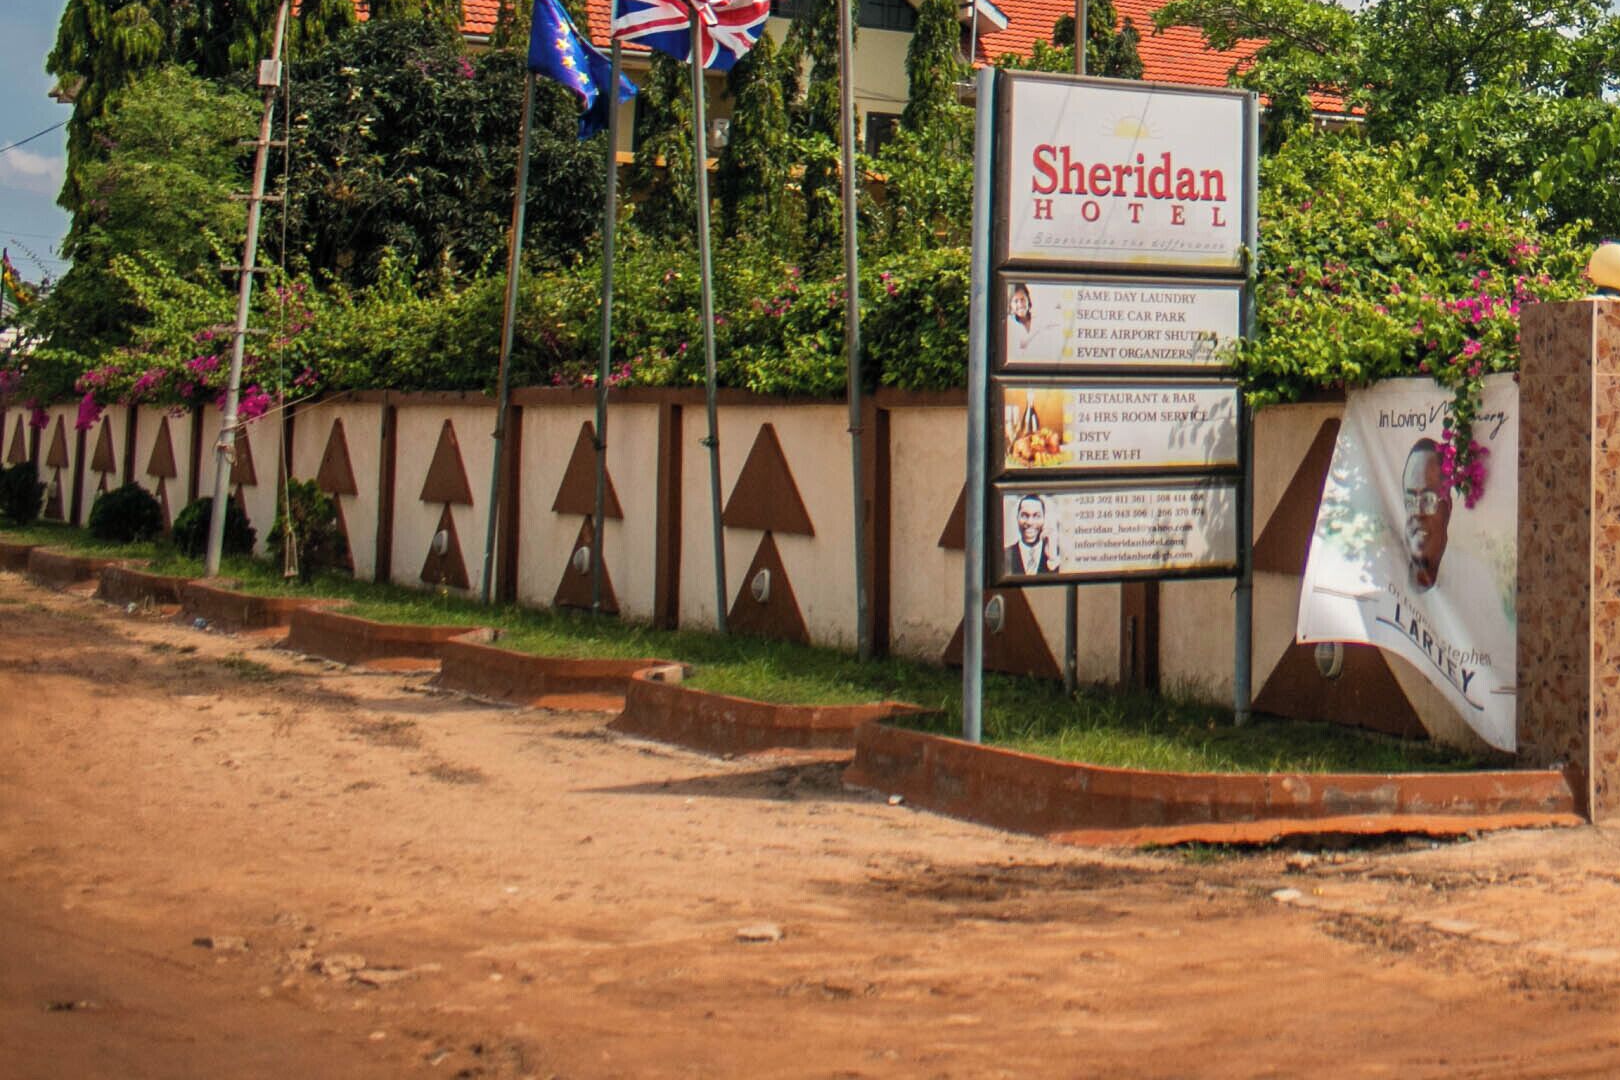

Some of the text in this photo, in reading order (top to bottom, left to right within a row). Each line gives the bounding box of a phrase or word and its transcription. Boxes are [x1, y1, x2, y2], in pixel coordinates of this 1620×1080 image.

[1031, 144, 1227, 201] Sheridan
[1033, 198, 1226, 227] HOTEL
[1078, 289, 1197, 304] SAME DAY LAUNDRY
[1077, 309, 1186, 322] SECURE CAR PARK
[1077, 328, 1108, 339] FREE
[1110, 329, 1161, 340] AIRPORT
[1077, 347, 1193, 359] EVENT ORGANIZERS
[1079, 392, 1197, 404] RESTAURANT & BAR
[1079, 411, 1209, 422] 24 HRS ROOM SERVICE
[1379, 410, 1389, 428] In
[1391, 409, 1427, 432] Loving
[1079, 431, 1111, 442] DSTV
[1079, 450, 1109, 461] FREE
